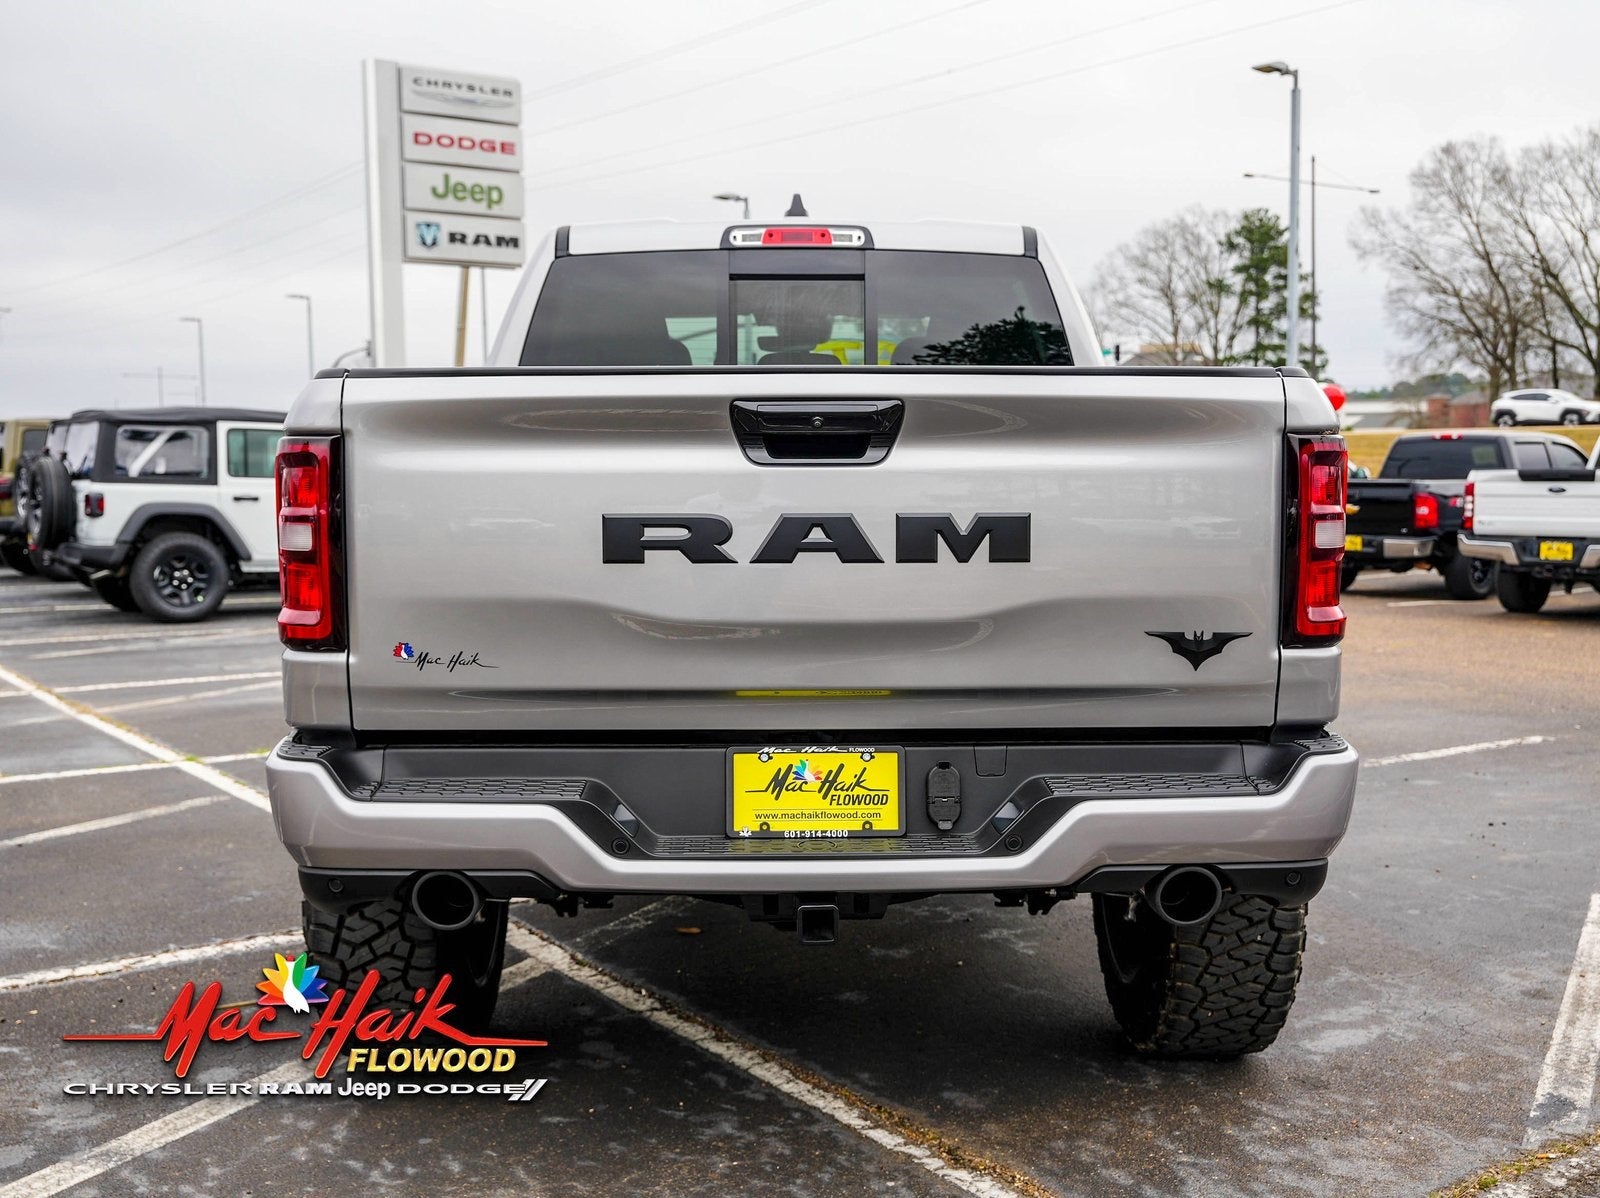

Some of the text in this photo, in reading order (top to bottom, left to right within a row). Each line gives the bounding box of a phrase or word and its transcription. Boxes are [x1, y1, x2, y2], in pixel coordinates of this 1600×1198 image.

[412, 76, 514, 97] CHRYSLER
[413, 131, 516, 155] DODGE
[431, 173, 504, 210] Jeep
[449, 231, 520, 249] RAM
[602, 513, 1031, 564] RAM
[396, 651, 499, 672] Mac Haik
[757, 746, 797, 754] Mac
[800, 746, 848, 754] Haik
[745, 763, 890, 801] Mac Haik
[829, 793, 889, 806] FLOWOOD
[755, 811, 881, 820] www.machaikflowood.com
[784, 830, 849, 838] 601-914-4000
